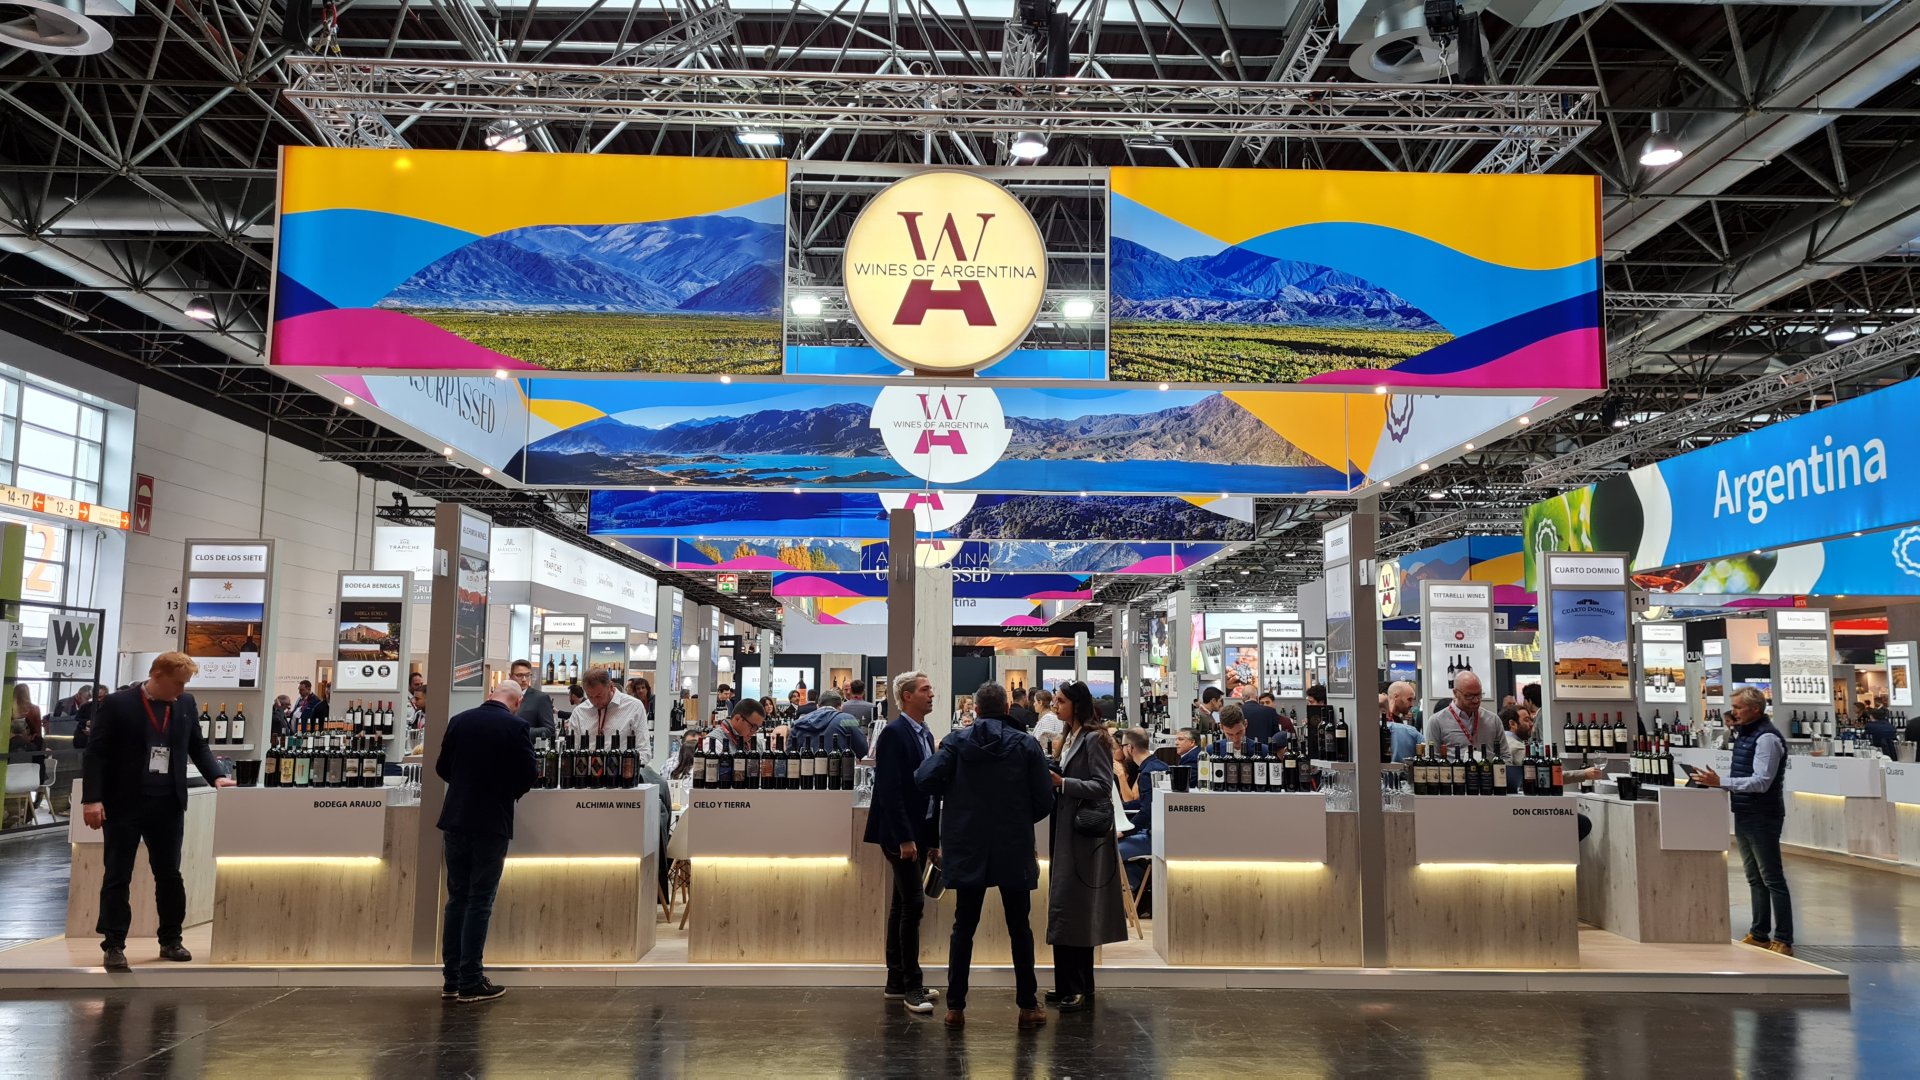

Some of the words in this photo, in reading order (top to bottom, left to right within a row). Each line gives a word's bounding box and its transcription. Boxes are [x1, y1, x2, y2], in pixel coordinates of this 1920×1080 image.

[854, 263, 908, 276] WINES
[913, 265, 935, 277] OF
[940, 265, 1037, 278] ARGENTINA
[893, 420, 922, 428] WINES
[938, 421, 989, 429] ARGENTINA
[1713, 435, 1887, 524] Argentina
[22, 494, 30, 506] 17
[56, 501, 64, 513] 12
[1555, 566, 1585, 574] CUARTO
[167, 601, 179, 610] 13
[1635, 597, 1645, 605] 11
[1561, 606, 1586, 615] CUARTO
[168, 614, 175, 622] A
[164, 626, 177, 635] 76
[56, 658, 93, 668] BRANDS
[575, 801, 614, 809] ALCHIMIA
[693, 801, 716, 809] CIELO
[724, 801, 751, 809] TIERRA
[1512, 808, 1531, 816] DON
[1532, 806, 1574, 816] CRISTÓBAL
